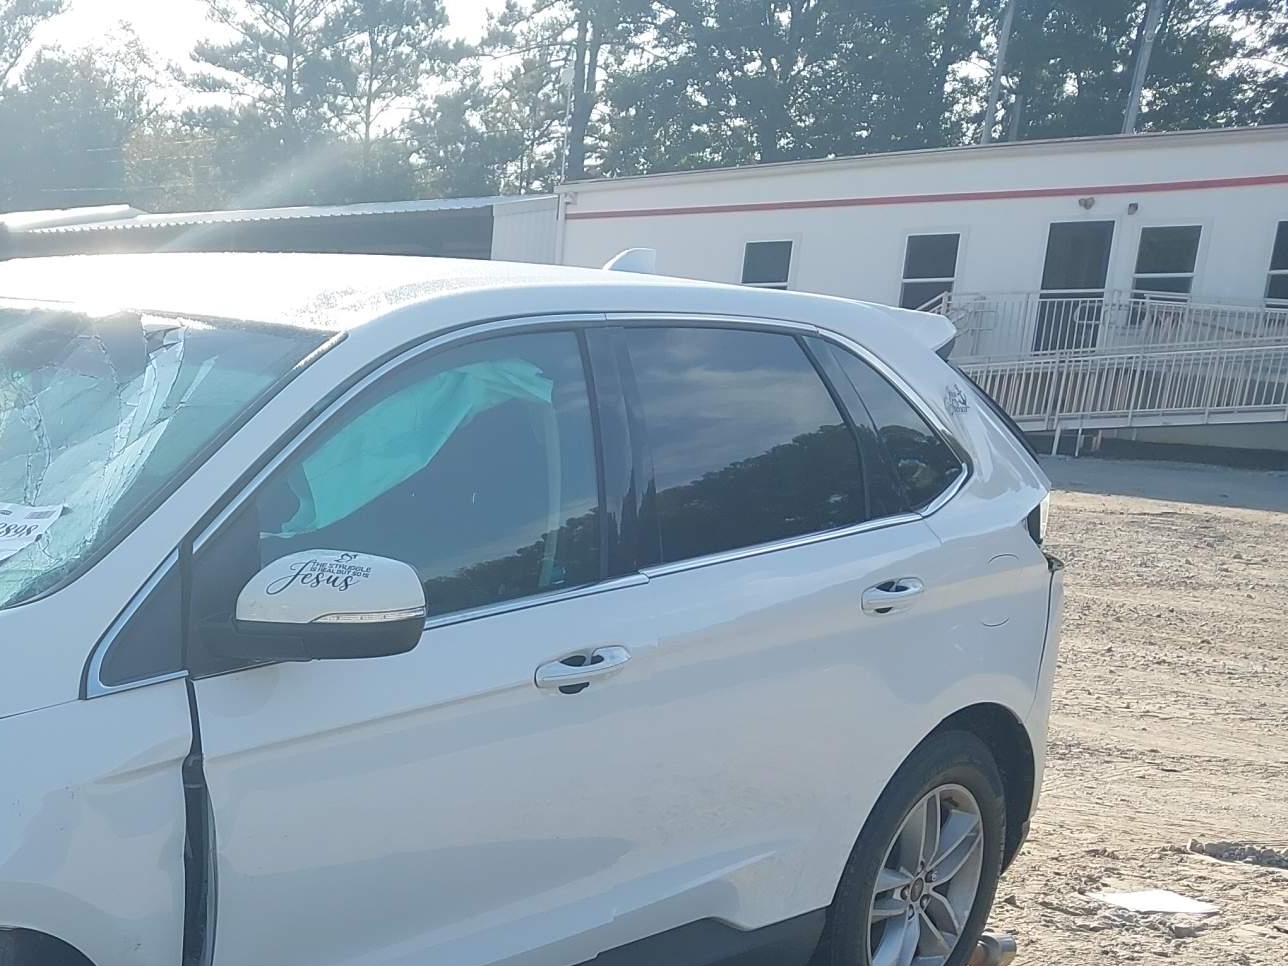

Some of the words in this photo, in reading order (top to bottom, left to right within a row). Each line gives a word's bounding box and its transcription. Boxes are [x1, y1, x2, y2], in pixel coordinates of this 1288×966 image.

[266, 560, 361, 596] Jesus
[311, 561, 328, 569] THE
[328, 563, 372, 573] STRUGGLE
